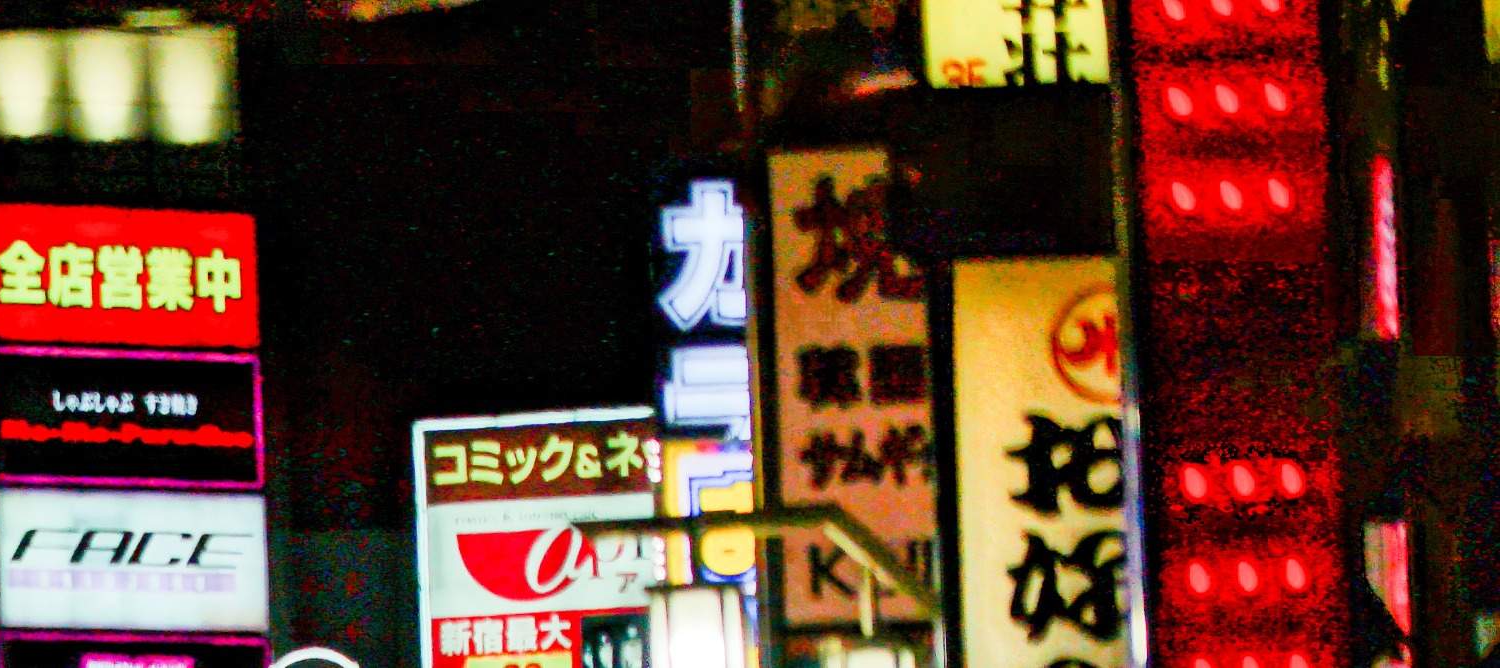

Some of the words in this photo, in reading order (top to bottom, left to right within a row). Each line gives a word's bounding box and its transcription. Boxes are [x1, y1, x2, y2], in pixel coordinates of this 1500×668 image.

[433, 430, 652, 486] コミック&ネ
[10, 528, 254, 570] FACE
[440, 616, 573, 657] 新宿最大
